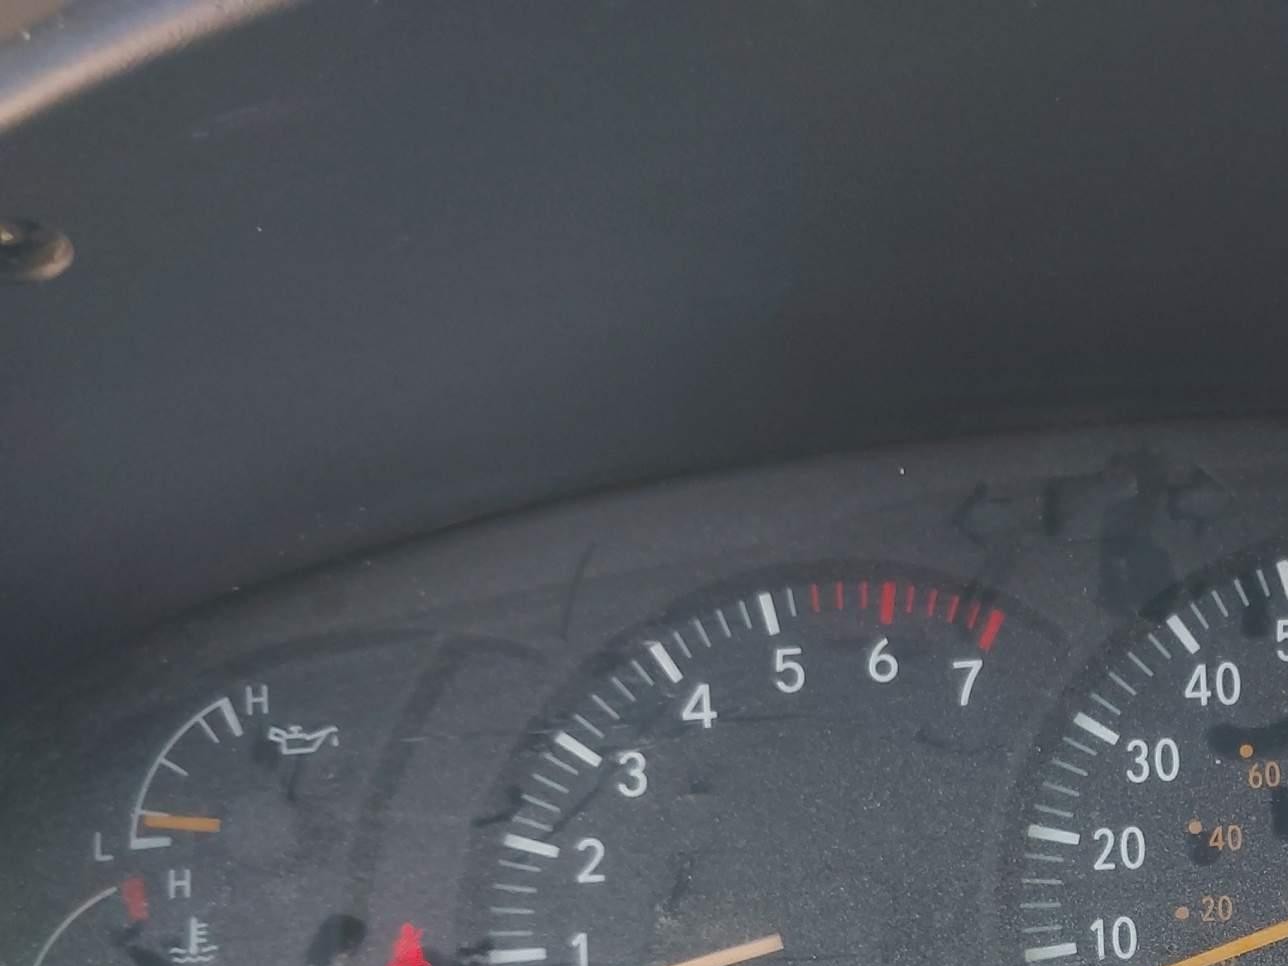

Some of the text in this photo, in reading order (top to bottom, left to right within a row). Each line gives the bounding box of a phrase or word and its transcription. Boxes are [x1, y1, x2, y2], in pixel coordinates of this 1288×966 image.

[774, 648, 805, 693] 5
[869, 639, 899, 682] 6
[246, 685, 268, 714] H
[953, 660, 983, 706] 7
[1184, 662, 1240, 706] 40
[682, 684, 717, 728] 4
[618, 752, 648, 797] 3
[1126, 738, 1180, 783] 30
[1248, 761, 1281, 789] 60
[94, 832, 113, 861] L
[1093, 826, 1146, 870] 20
[1209, 825, 1243, 850] 40
[576, 838, 605, 883] 2
[169, 870, 190, 898] H
[1202, 895, 1233, 922] 20
[1090, 916, 1137, 960] 10
